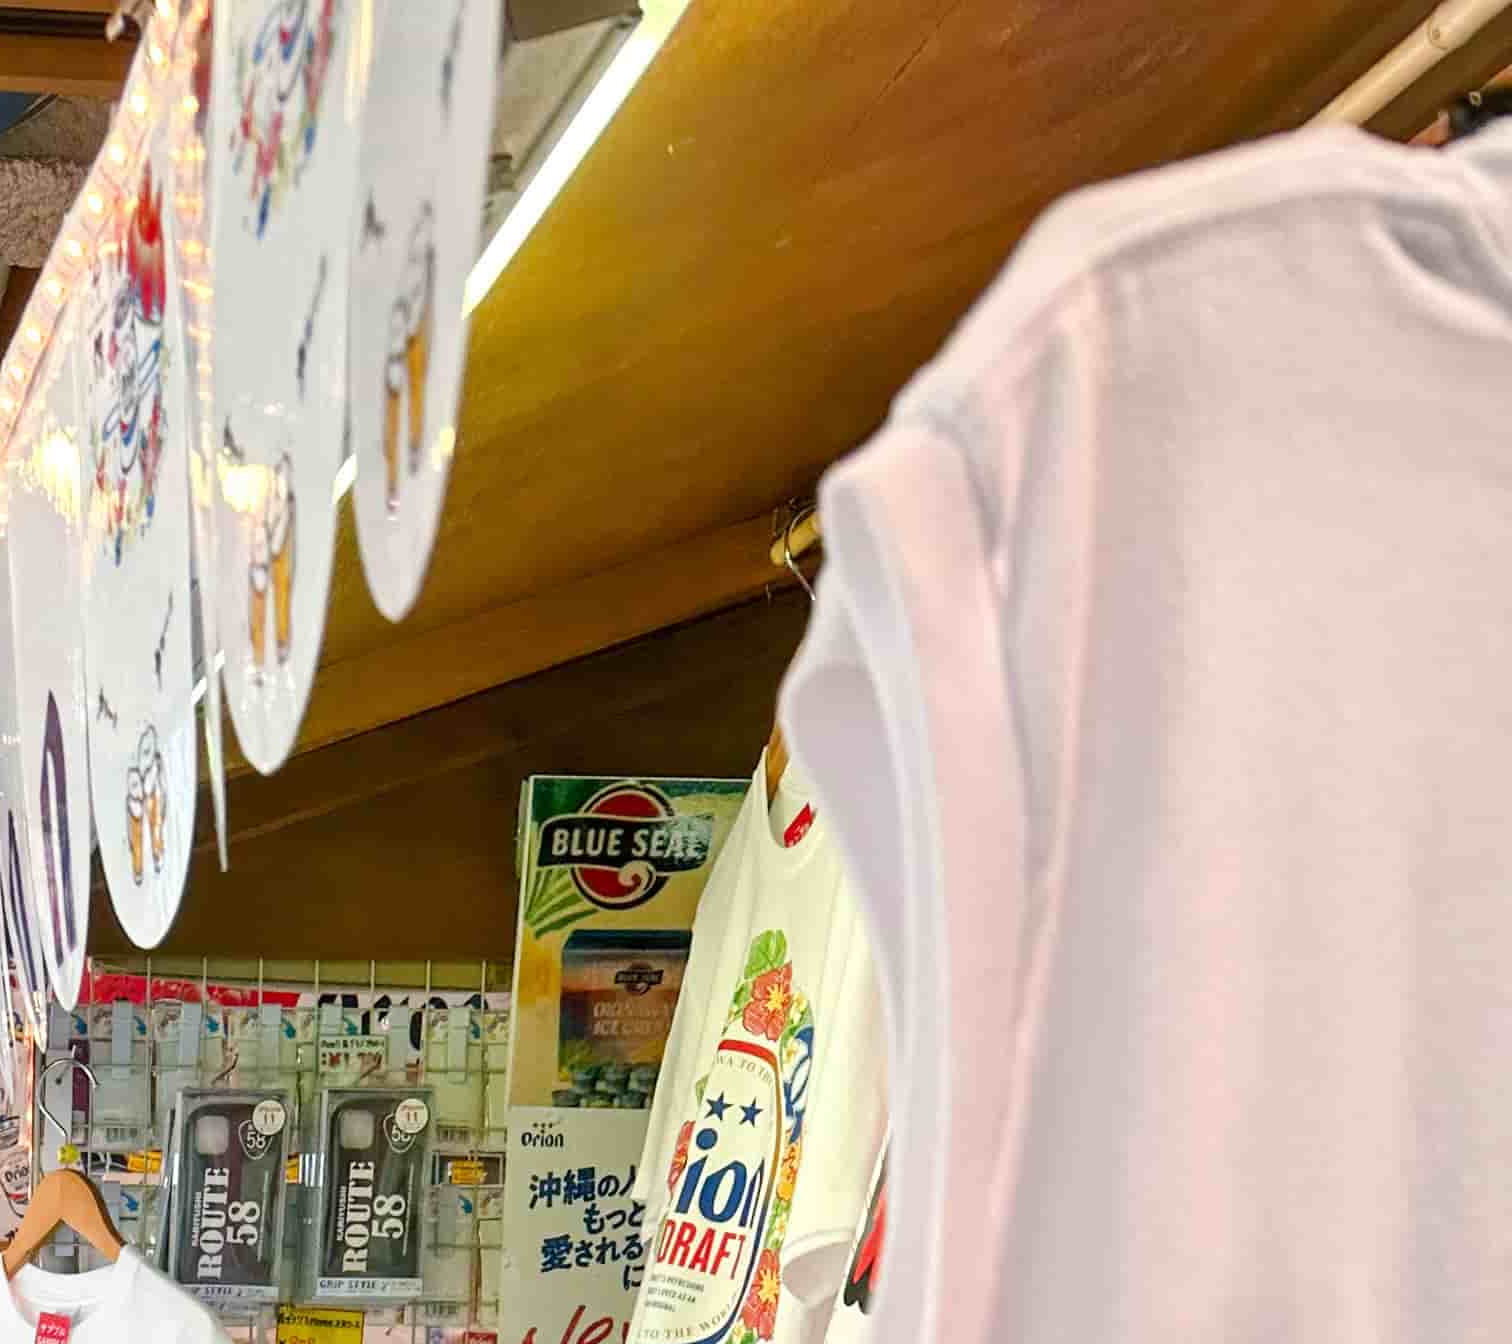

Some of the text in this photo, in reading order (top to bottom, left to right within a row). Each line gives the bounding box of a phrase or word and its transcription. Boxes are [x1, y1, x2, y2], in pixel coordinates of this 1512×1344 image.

[551, 828, 624, 857] BLUE
[520, 1128, 564, 1149] Orion
[196, 1167, 230, 1280] ROUTE
[226, 1200, 261, 1247] 58
[342, 1161, 376, 1273] ROUTE
[370, 1194, 407, 1240] 58
